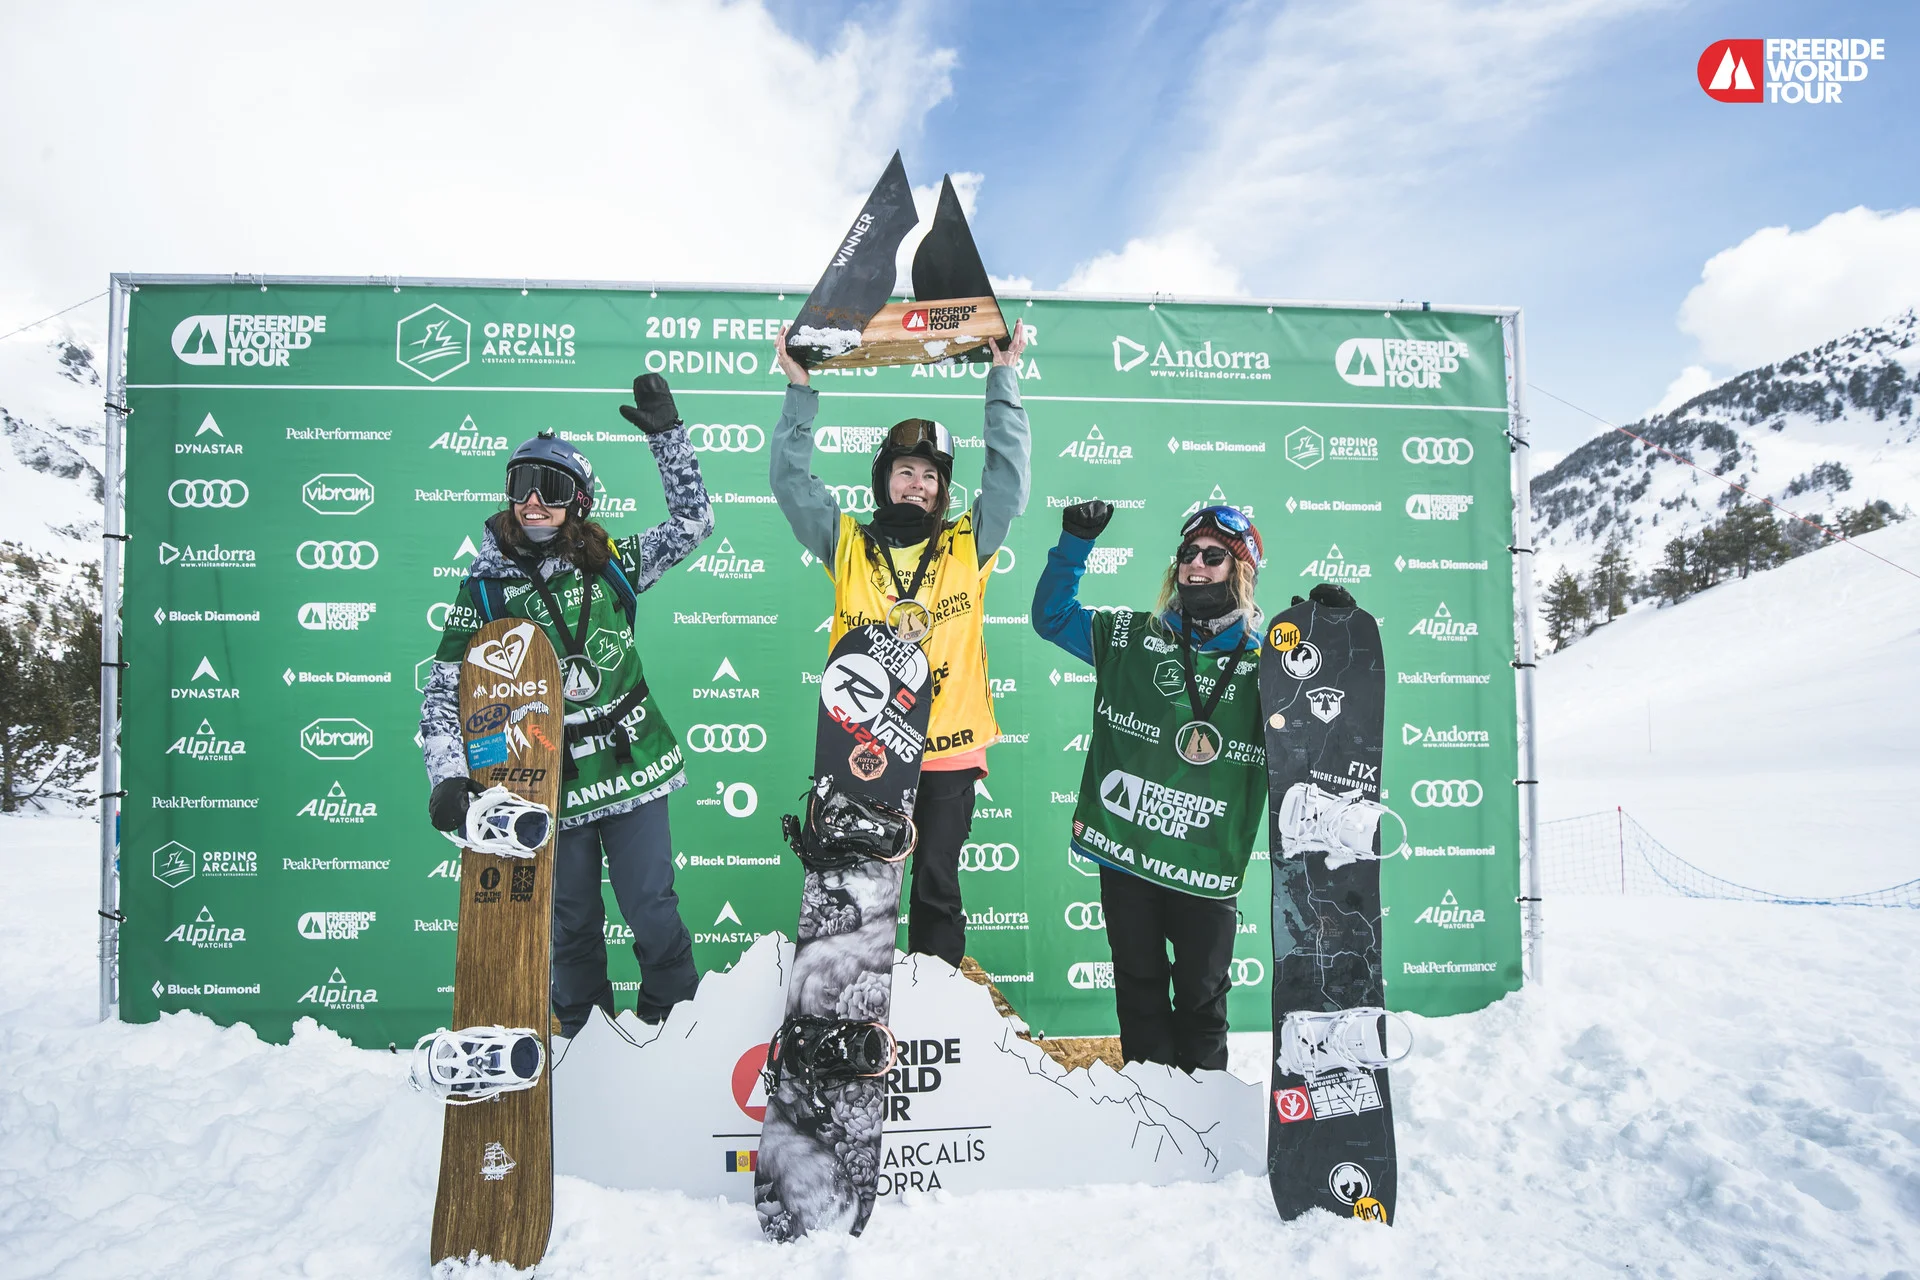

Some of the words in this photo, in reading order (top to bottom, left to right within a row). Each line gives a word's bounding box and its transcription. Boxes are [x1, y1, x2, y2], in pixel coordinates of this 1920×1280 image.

[833, 213, 875, 267] WINNER
[930, 306, 977, 314] FREERIDE
[930, 313, 970, 322] WORLD
[229, 315, 326, 332] FREERIDE
[484, 323, 575, 339] ORDINO
[646, 317, 701, 339] 2019
[713, 319, 794, 340] FREE
[929, 322, 959, 330] TOUR
[229, 332, 311, 349] WORLD
[482, 336, 575, 357] ARCALÍS
[1385, 339, 1469, 358] FREERIDE
[228, 349, 290, 366] TOUR
[1151, 341, 1271, 370] Andorra
[645, 350, 758, 374] ORDINO
[911, 362, 1041, 380] ANDORA
[1385, 356, 1459, 373] WORLD
[1151, 370, 1271, 380] www.visitandorra.com
[1386, 370, 1441, 389] TOUR
[560, 431, 593, 441] Black
[842, 427, 888, 437] FREERIDE
[842, 436, 882, 444] WORLD
[175, 444, 243, 454] DYNASTAR
[429, 432, 508, 453] Alpina
[842, 444, 872, 453] TOUR
[1182, 441, 1211, 451] Black
[1213, 442, 1265, 452] Diamond
[1330, 437, 1377, 447] ORDINO
[1059, 442, 1133, 460] Alpina
[307, 483, 370, 502] vibram
[415, 489, 508, 502] PeakPerforman
[1431, 495, 1473, 504] FREERIDE
[591, 494, 637, 511] pina
[1300, 501, 1329, 510] Black
[1332, 501, 1382, 512] Diamond
[1431, 503, 1468, 512] WORLD
[1431, 512, 1459, 520] TOUR
[181, 544, 256, 561] Andorra
[1088, 556, 1127, 565] WORLD
[433, 568, 469, 577] DYNA
[688, 555, 765, 576] Alpina
[1088, 565, 1117, 574] TOUR
[1300, 561, 1372, 579] Alpina
[1409, 559, 1437, 569] Black
[1440, 560, 1487, 570] Diamond
[564, 584, 599, 598] ORDO
[327, 603, 376, 612] FREERIDE
[936, 592, 967, 611] RDINO
[169, 611, 202, 621] Black
[205, 611, 259, 622] Diamond
[327, 612, 369, 621] WORLD
[327, 621, 358, 630] TOUR
[1119, 613, 1132, 647] RDINO
[1408, 618, 1478, 638] Alpina
[864, 625, 911, 665] NORTH
[868, 645, 900, 676] FACE
[299, 672, 333, 683] Black
[337, 672, 391, 683] Diamond
[1064, 673, 1097, 682] Black
[1194, 674, 1236, 692] ORDO
[171, 689, 239, 699] DYNASTAR
[693, 689, 760, 698] DYNASTAR
[473, 708, 504, 726] bca
[1101, 706, 1160, 738] Andorra
[305, 727, 369, 746] vibram
[870, 712, 922, 763] VANS
[925, 729, 974, 754] ADER
[1423, 726, 1489, 742] Andorra
[166, 737, 246, 758] Alpina
[862, 763, 874, 772] 153
[1348, 761, 1378, 781] FIX
[1313, 771, 1332, 782] NICHE
[1333, 775, 1377, 793] SNOWBOARDS
[566, 776, 630, 808] ANNA
[1142, 781, 1227, 816] FREERIDE
[297, 798, 377, 820] Alpina
[697, 798, 721, 806] ordino
[974, 809, 1012, 818] ASTAR
[1141, 795, 1210, 829] WORLD
[1137, 810, 1189, 840] TOUR
[1083, 826, 1134, 864] ERIKA
[1415, 846, 1445, 856] Black
[1447, 846, 1495, 856] Diamond
[203, 852, 257, 862] ORDINO
[691, 856, 724, 866] Black
[727, 855, 780, 866] Diamond
[327, 912, 376, 922] FREERIDE
[1414, 907, 1485, 925] Alpina
[327, 921, 369, 930] WORLD
[165, 925, 246, 946] Alpina
[327, 930, 359, 939] TOUR
[168, 985, 201, 994] Black
[204, 984, 260, 994] Diamond
[298, 986, 378, 1007] Alpina
[895, 1039, 960, 1066] RIDE
[885, 1067, 941, 1094] RLD
[884, 1134, 985, 1169] ARCALÍS
[878, 1170, 941, 1196] ORRA
